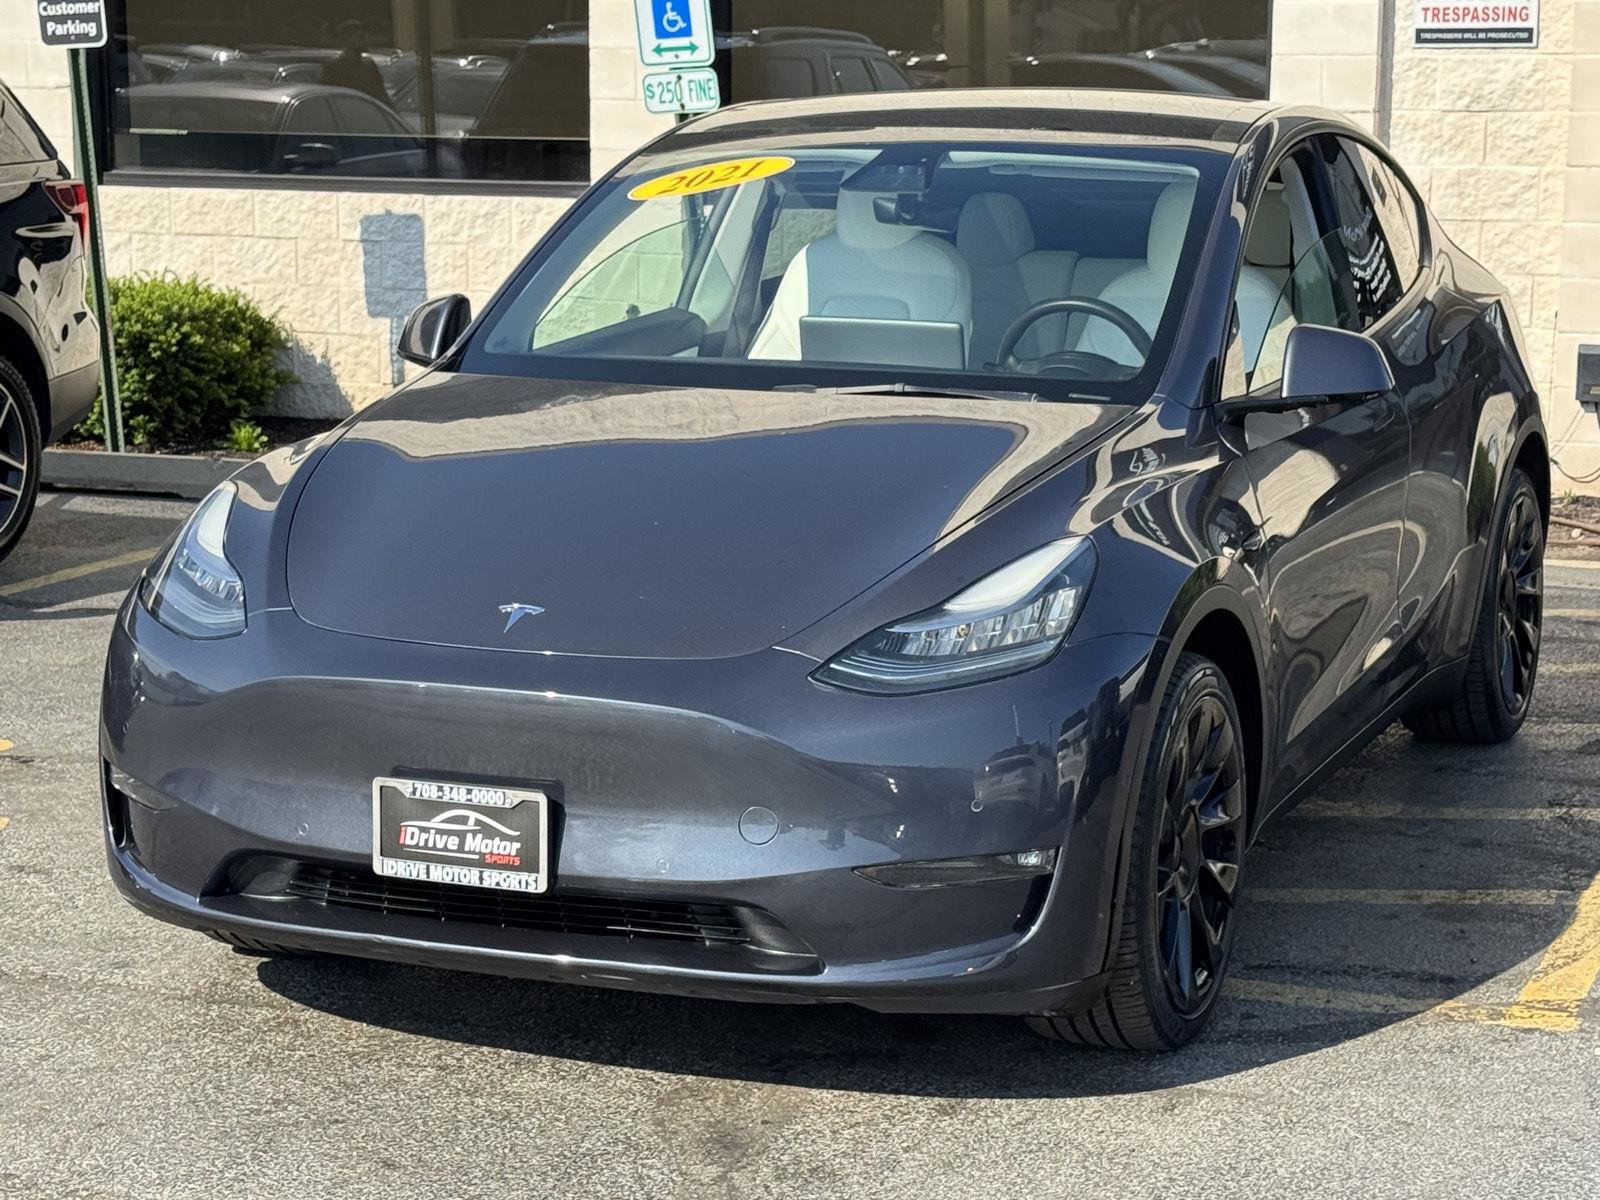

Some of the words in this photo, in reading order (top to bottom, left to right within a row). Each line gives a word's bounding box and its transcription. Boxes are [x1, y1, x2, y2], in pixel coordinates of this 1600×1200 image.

[39, 1, 100, 16] Customer
[1422, 6, 1529, 23] TRESPASSING
[46, 19, 97, 37] Parking
[646, 80, 683, 104] $250
[688, 78, 716, 102] FINE
[655, 160, 766, 195] 2021
[413, 783, 505, 806] 708-348-0000
[399, 826, 459, 851] iDrive
[464, 832, 521, 857] Motor
[484, 854, 521, 866] SPORTS
[429, 866, 480, 885] MOTOR
[482, 870, 538, 890] SPORTS
